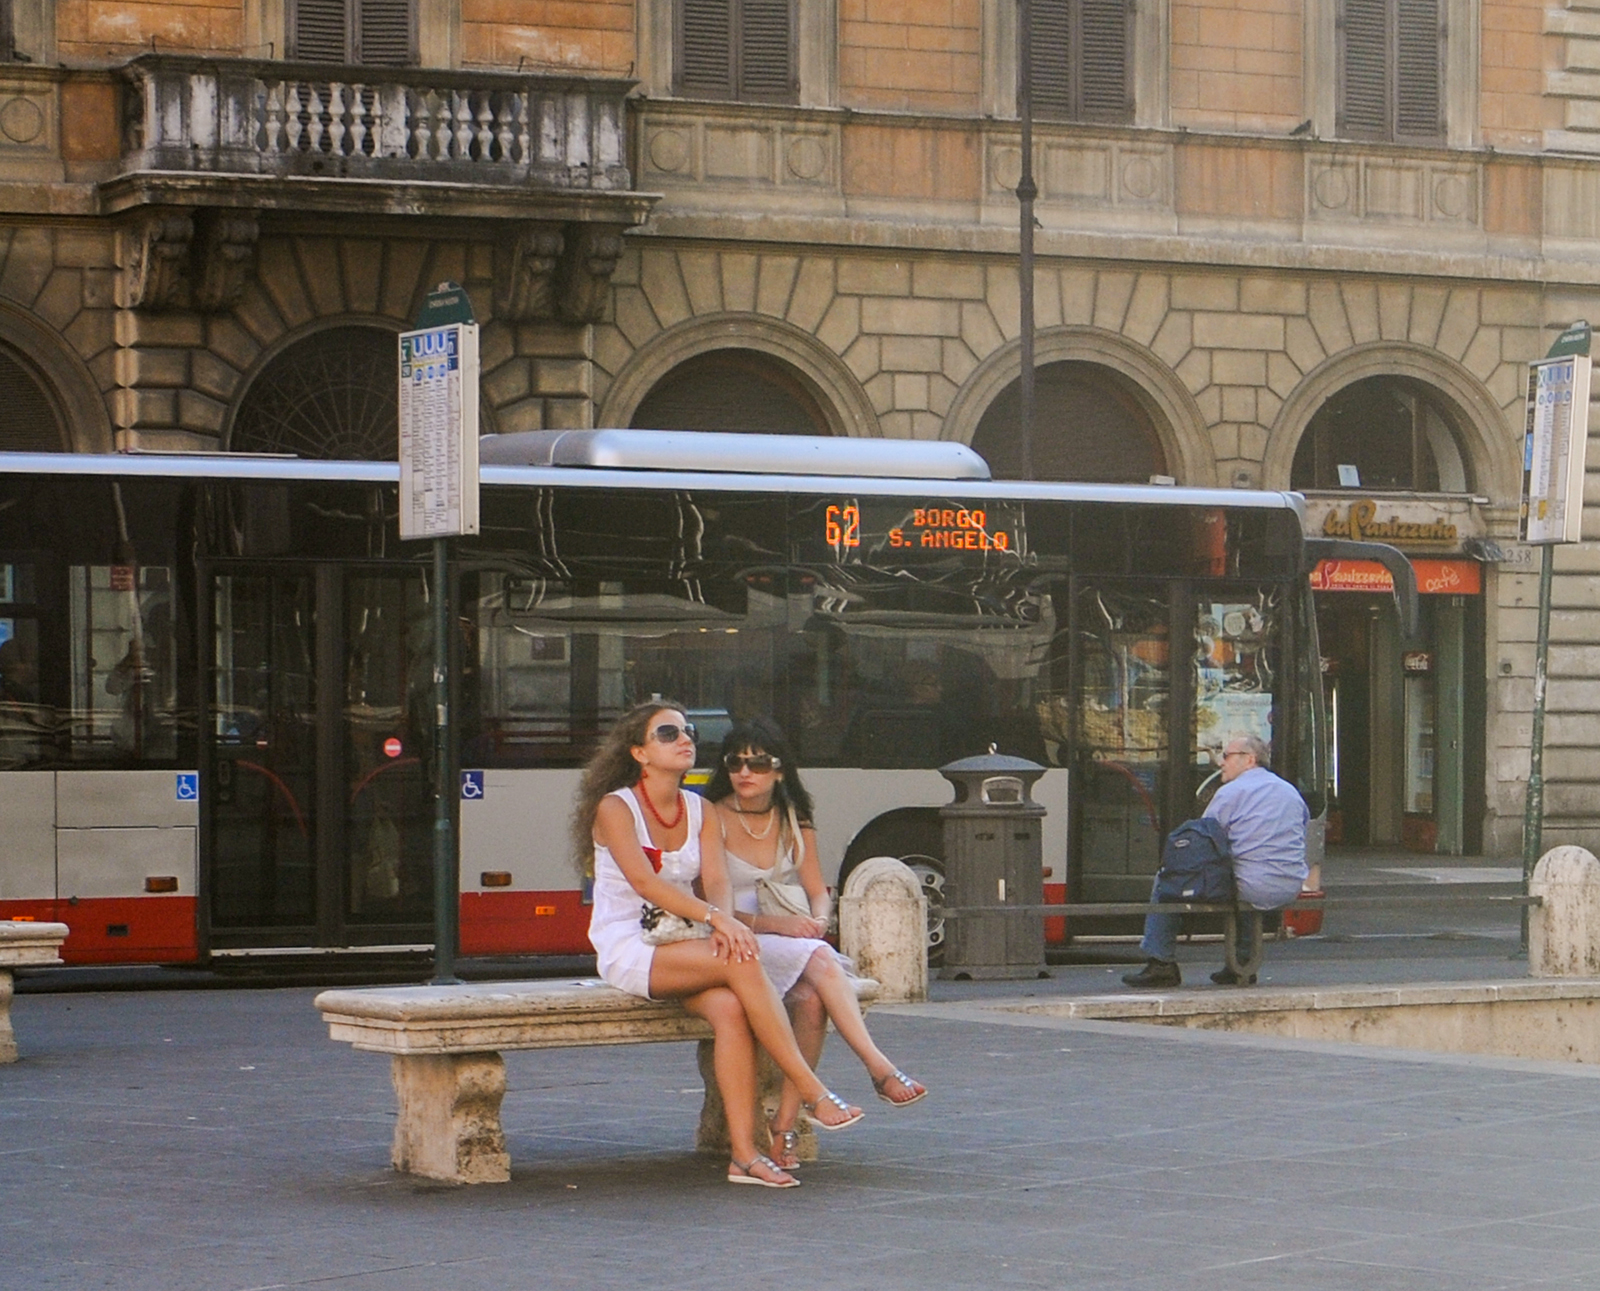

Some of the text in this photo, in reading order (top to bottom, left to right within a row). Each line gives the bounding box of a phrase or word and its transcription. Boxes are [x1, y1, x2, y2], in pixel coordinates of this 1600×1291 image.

[826, 505, 860, 547] 62
[913, 509, 986, 528] BORGO
[1350, 499, 1457, 541] Panizzeria
[889, 528, 1008, 550] S. ANGELO
